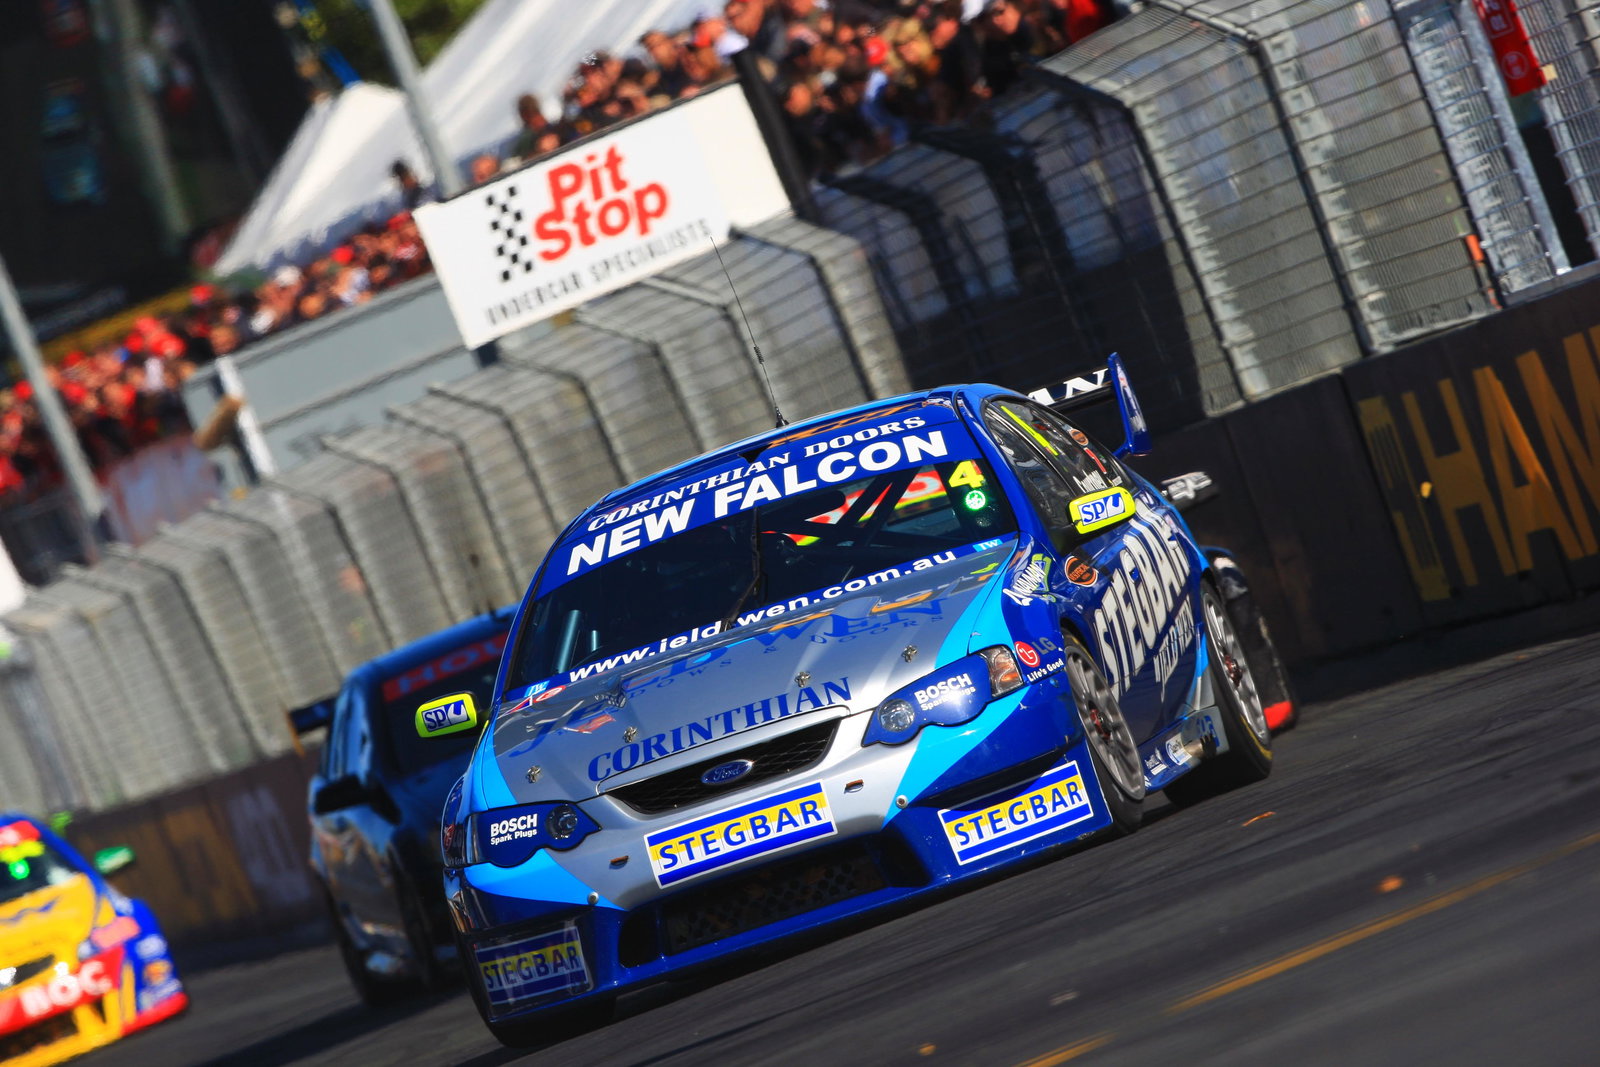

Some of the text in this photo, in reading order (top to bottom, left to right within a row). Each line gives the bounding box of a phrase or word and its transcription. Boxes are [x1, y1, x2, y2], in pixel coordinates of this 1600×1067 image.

[547, 144, 627, 212] Pit
[535, 183, 668, 261] Stop
[485, 218, 711, 325] UNDERCAR SPECIALISTS
[588, 416, 926, 532] CORINTHIAN DOORS
[949, 460, 985, 488] 4
[1401, 326, 1600, 586] HAM
[566, 430, 948, 576] NEW FALCON
[1094, 497, 1190, 703] STEGBAR
[1026, 658, 1064, 682] Life's Good
[1031, 637, 1054, 653] LG
[914, 673, 972, 704] BOSCH
[588, 676, 852, 782] CORINTHIAN
[712, 764, 741, 781] Ford
[490, 814, 538, 837] BOSCH
[490, 828, 537, 845] Spark Plugs
[659, 800, 824, 869] STEGBAR
[953, 780, 1083, 846] STEGBAR
[483, 946, 580, 990] STEGBAR
